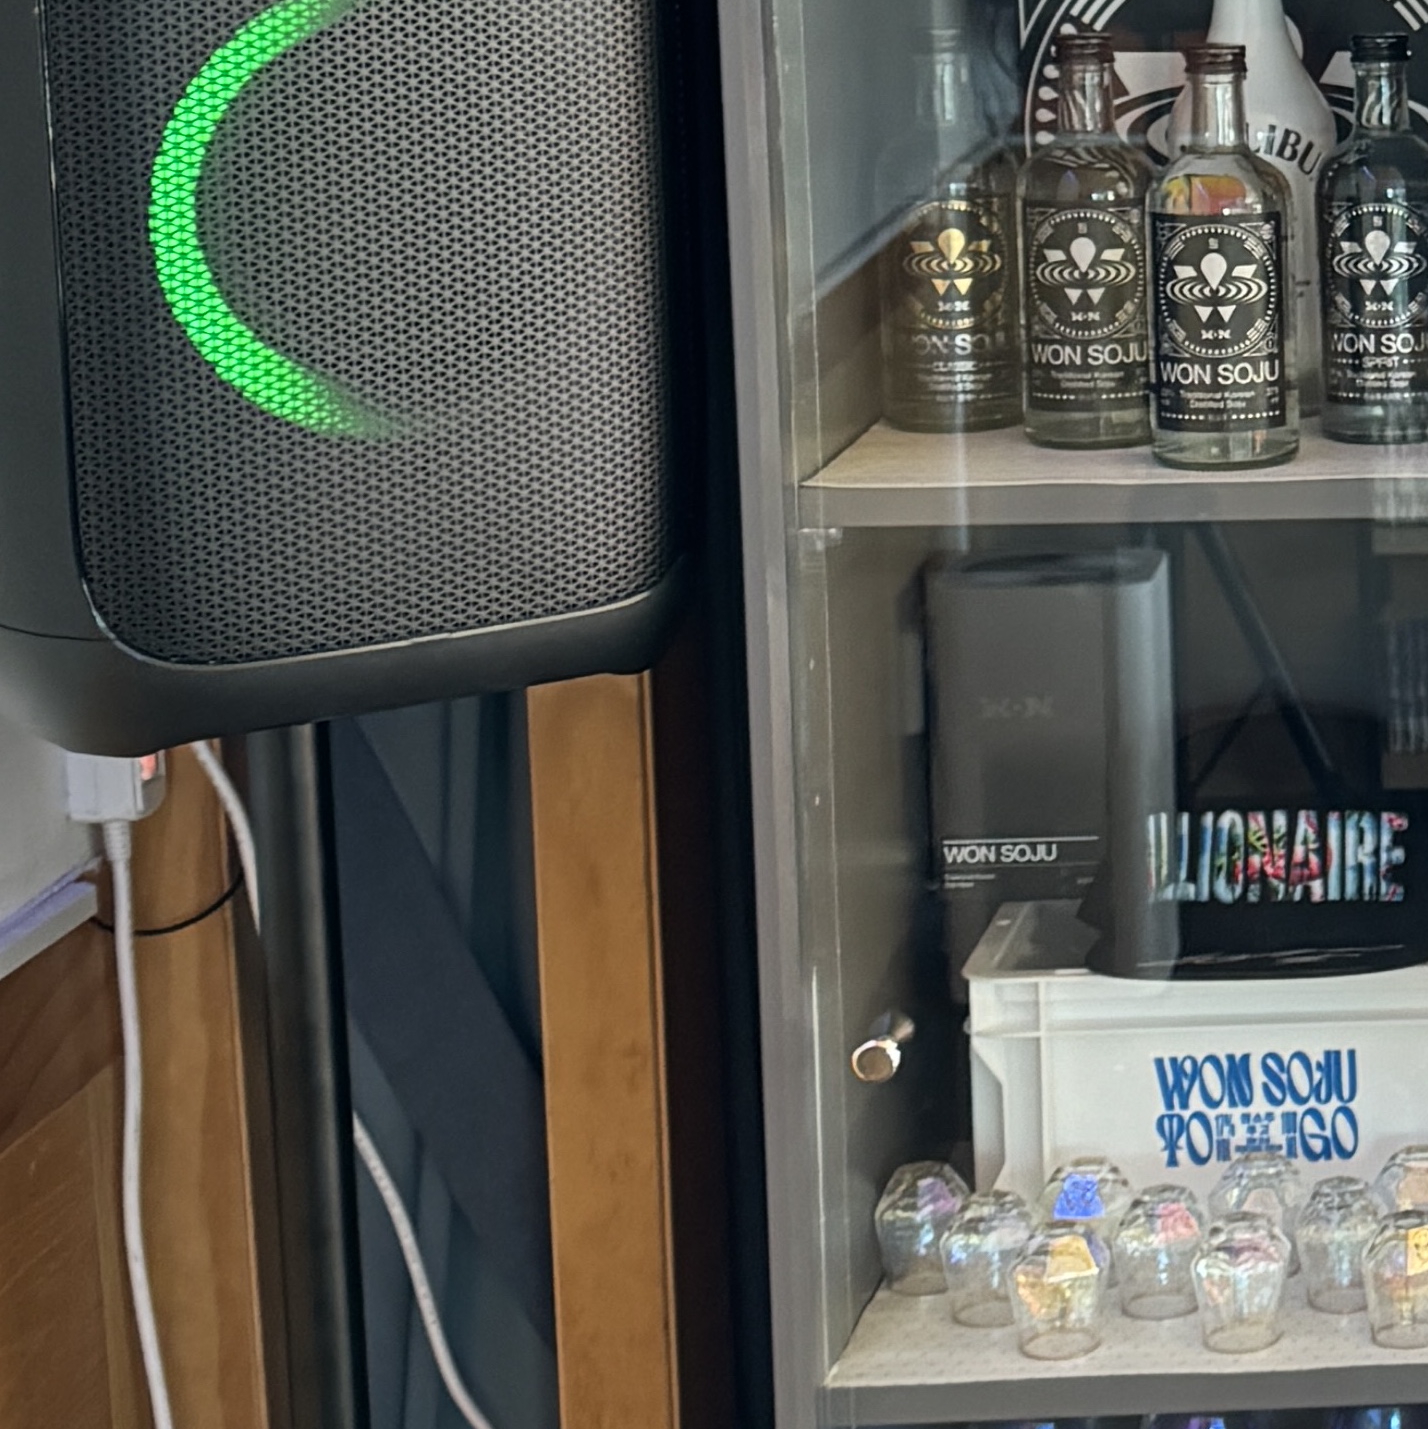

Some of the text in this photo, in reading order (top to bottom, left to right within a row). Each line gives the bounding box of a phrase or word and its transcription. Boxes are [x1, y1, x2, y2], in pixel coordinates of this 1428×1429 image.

[1031, 341, 1148, 366] WON SOJU
[1160, 359, 1280, 385] WON SOJU
[943, 843, 1058, 864] WON SOJU
[1146, 809, 1410, 903] ILLIONAIRE
[1154, 1049, 1358, 1111] WON SOJU
